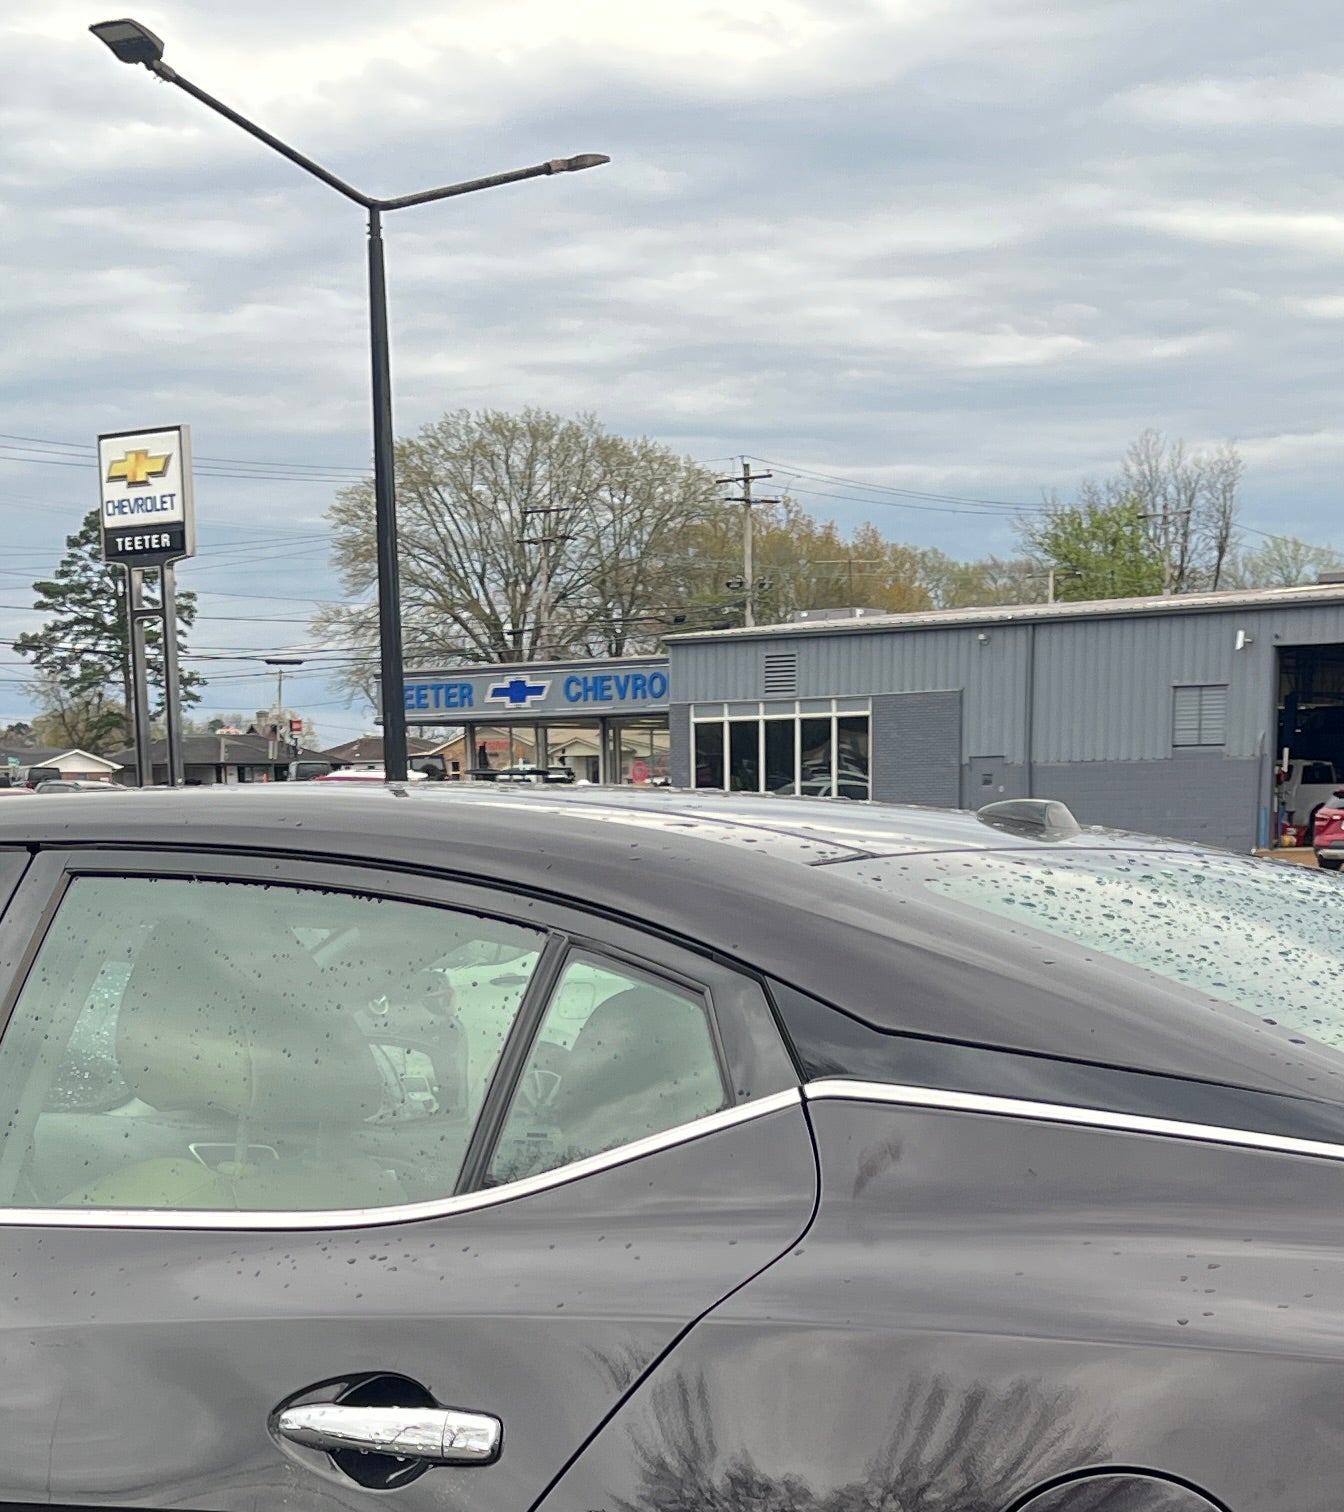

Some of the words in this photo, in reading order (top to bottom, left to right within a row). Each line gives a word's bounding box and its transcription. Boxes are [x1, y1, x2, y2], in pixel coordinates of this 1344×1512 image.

[105, 493, 176, 516] CHEVROLET
[116, 533, 171, 551] TEETER
[402, 682, 474, 709] EETER
[563, 671, 670, 702] CHEVRO
